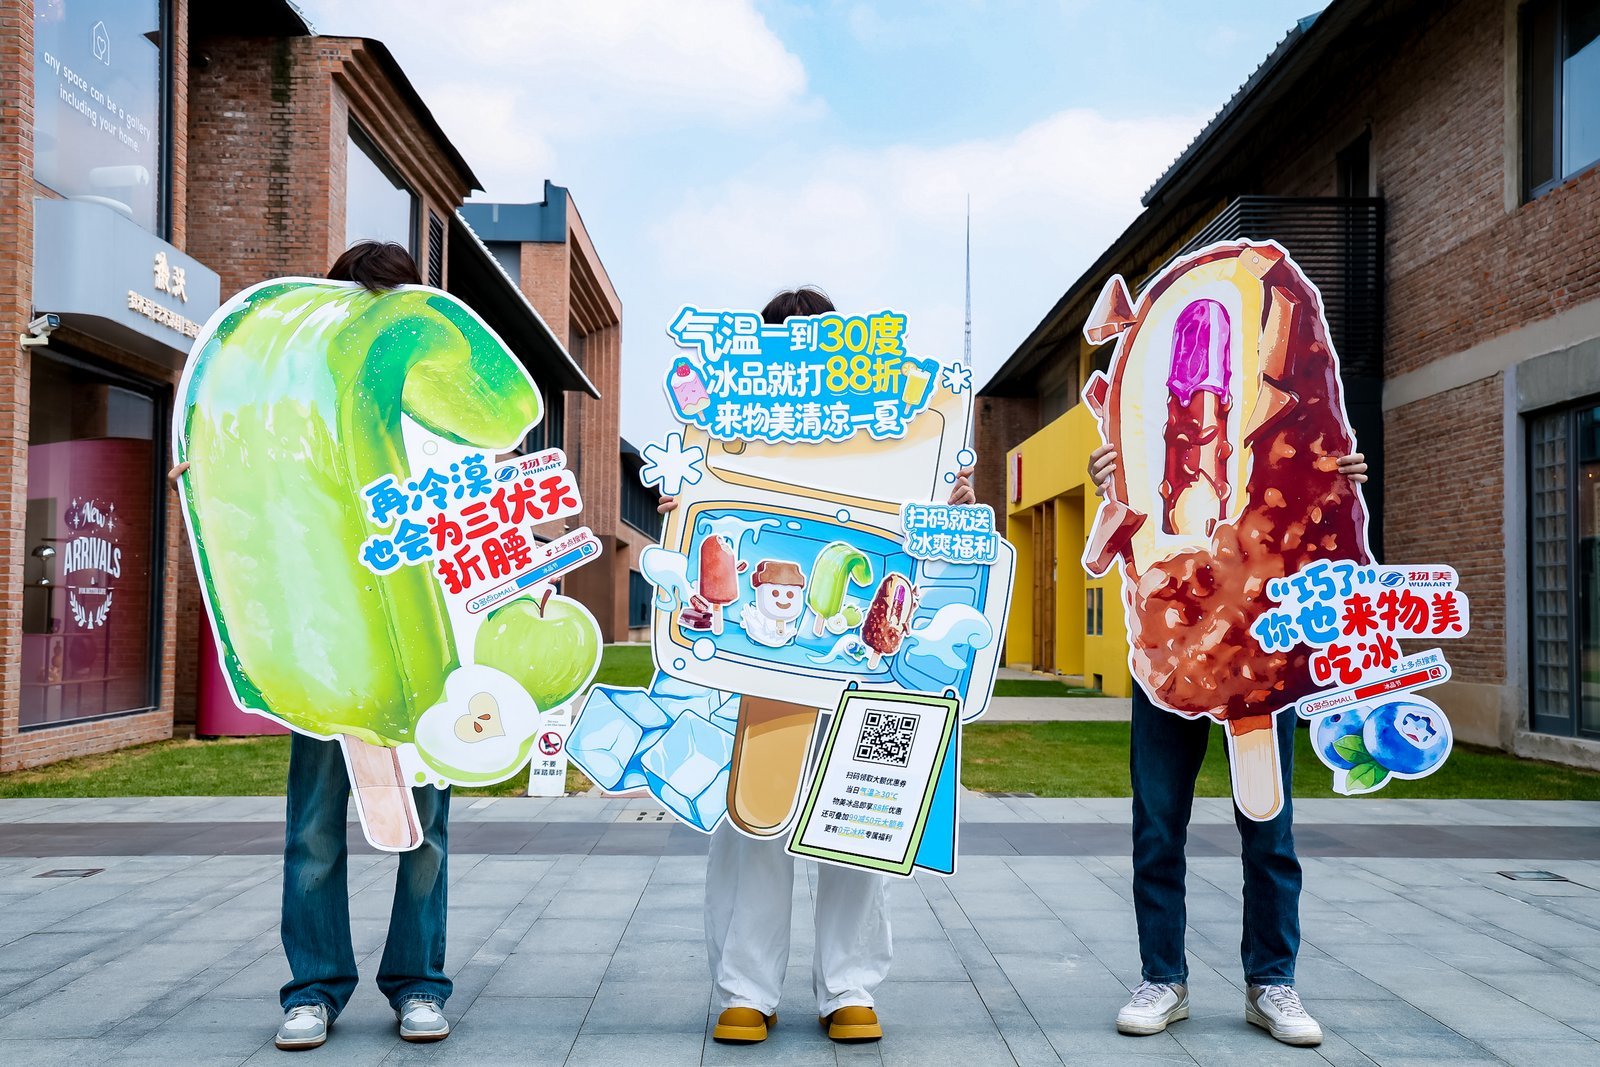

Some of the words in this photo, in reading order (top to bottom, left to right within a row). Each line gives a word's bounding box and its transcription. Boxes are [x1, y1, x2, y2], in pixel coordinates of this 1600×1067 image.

[44, 52, 60, 75] any
[63, 66, 88, 91] space
[90, 86, 104, 105] can
[107, 95, 117, 114] be
[119, 108, 124, 119] a
[126, 114, 151, 142] gallery
[60, 83, 97, 127] including
[99, 115, 117, 136] your
[119, 126, 140, 152] home.
[674, 311, 903, 361] 气温一到30度
[706, 355, 902, 399] 冰品就打88折
[714, 399, 901, 436] 来物美清凉一夏
[520, 452, 560, 470] 物美
[522, 462, 562, 477] WUMART
[366, 453, 492, 523] 再冷漠
[82, 500, 105, 528] New
[364, 475, 577, 571] 也会为三伏天
[907, 505, 990, 532] 扫码就送
[63, 536, 121, 578] ARRIVALS
[438, 527, 532, 594] 折腰
[554, 532, 588, 554] 上多点搜索
[911, 531, 996, 559] 冰爽福利
[1408, 571, 1452, 581] 物美
[1255, 589, 1463, 648] 你也来物美
[1314, 633, 1399, 685] 吃冰
[1400, 654, 1438, 671] 上多点搜索
[845, 771, 907, 788] 扫码领取大额优惠券
